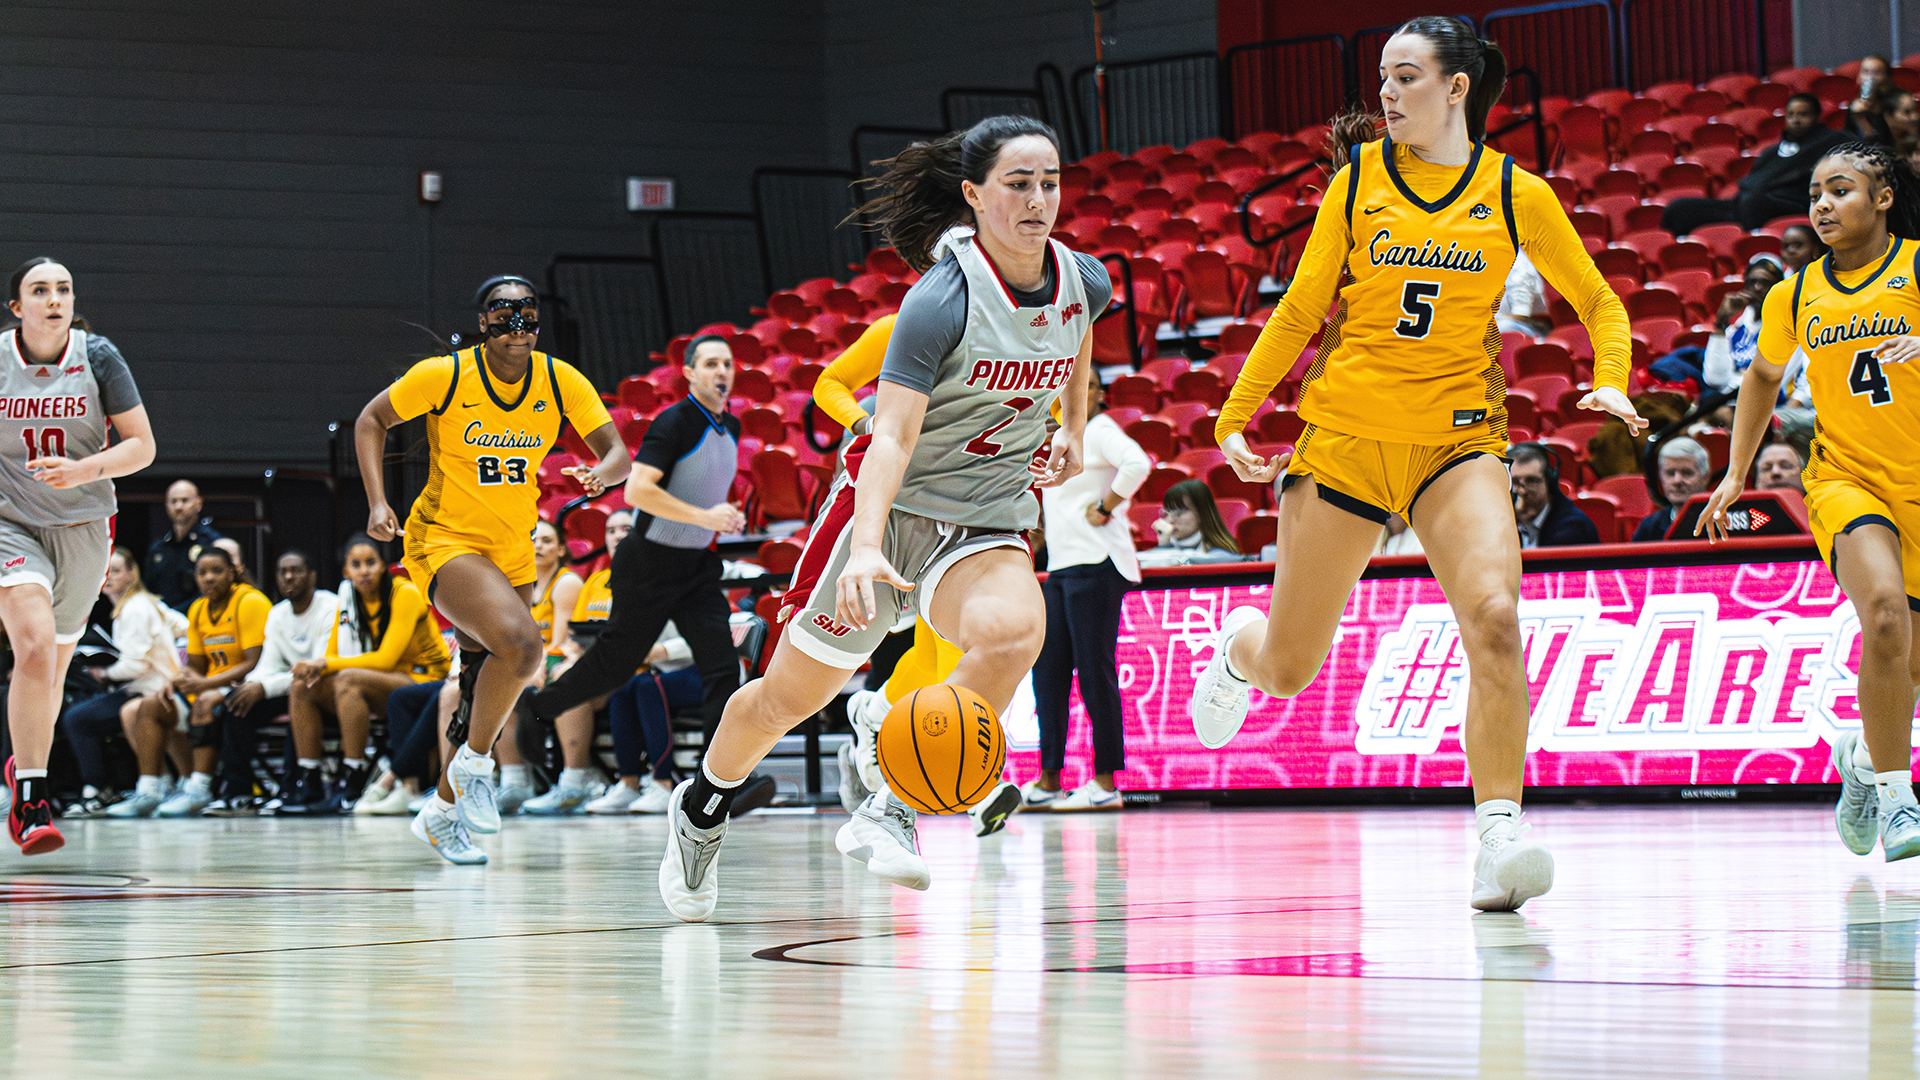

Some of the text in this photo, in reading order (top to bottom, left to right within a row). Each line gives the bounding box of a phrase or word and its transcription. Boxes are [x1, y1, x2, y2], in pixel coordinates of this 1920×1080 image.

[1368, 228, 1487, 273] Canisius
[1392, 279, 1441, 340] 5
[1805, 310, 1912, 351] Canisius
[1847, 346, 1894, 407] 4
[22, 427, 67, 470] 10
[463, 419, 545, 449] Canisius
[961, 395, 1036, 457] 2
[476, 454, 529, 486] 23
[972, 701, 991, 752] EVO
